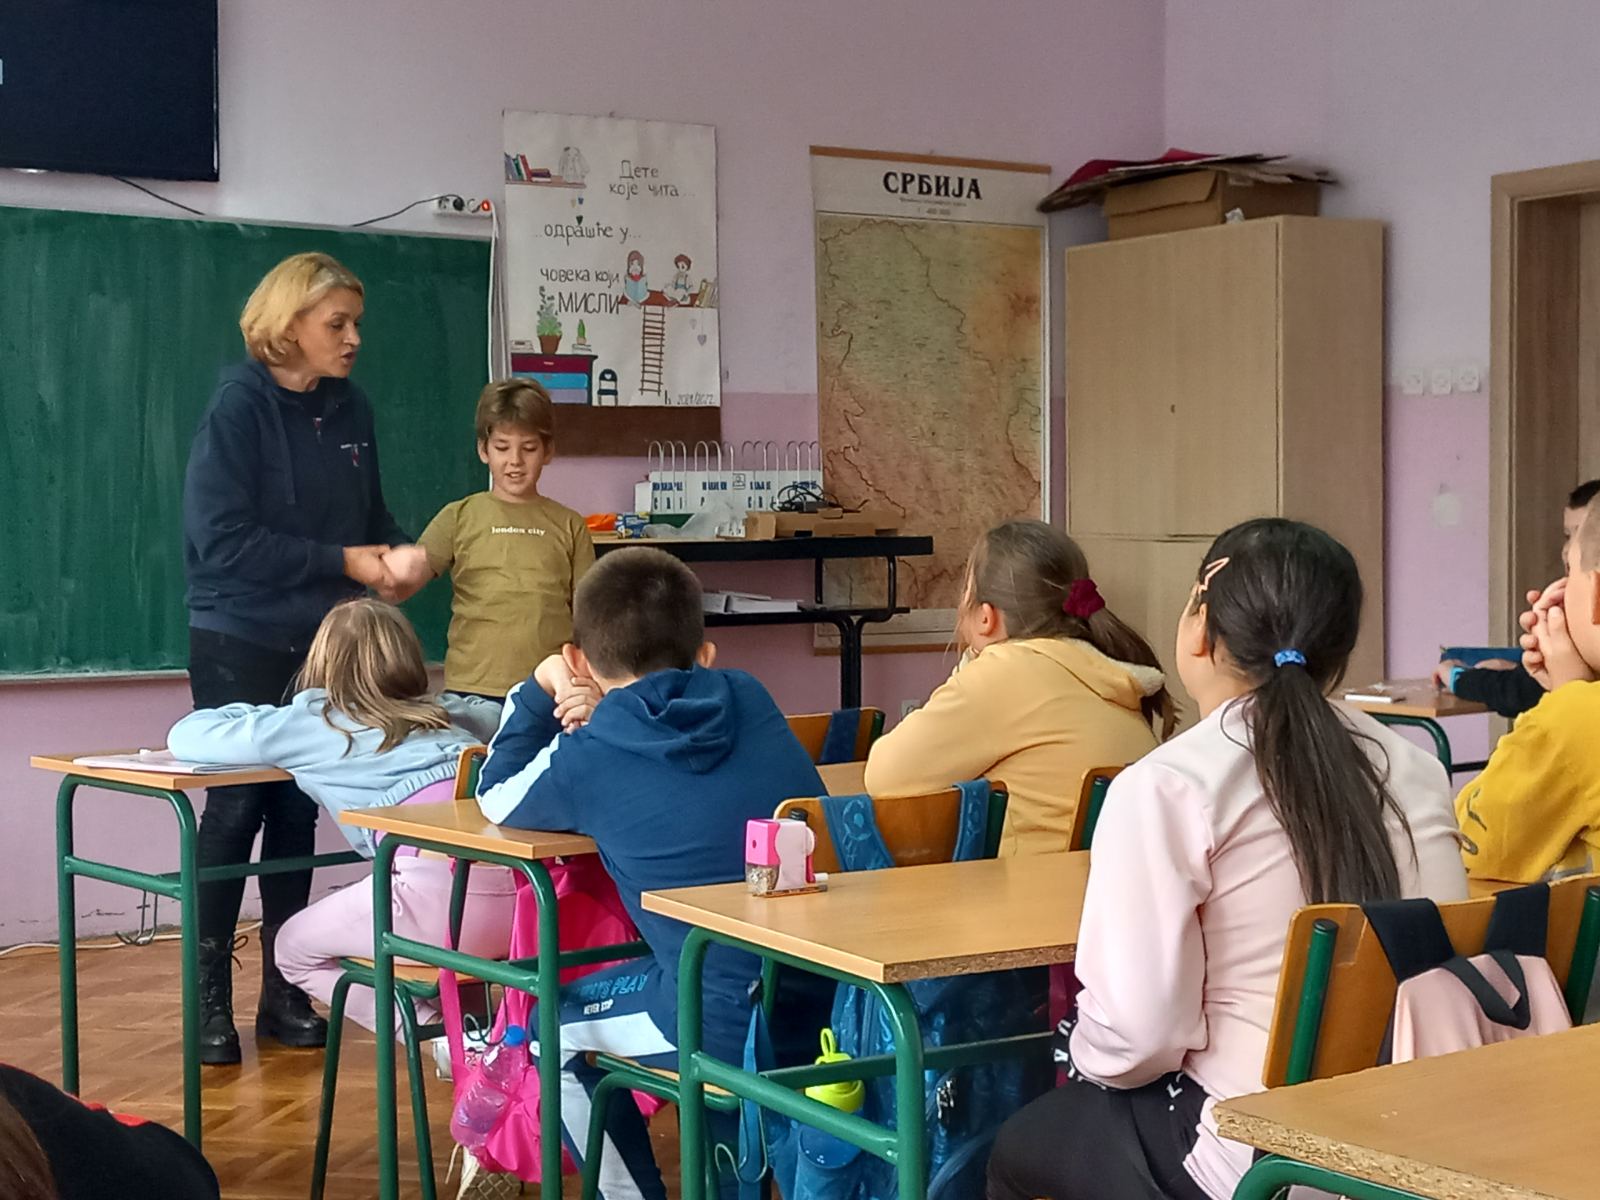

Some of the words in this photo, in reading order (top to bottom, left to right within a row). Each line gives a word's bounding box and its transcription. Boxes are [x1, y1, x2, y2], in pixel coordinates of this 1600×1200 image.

[619, 159, 659, 179] Дете
[609, 181, 640, 200] које
[882, 171, 983, 200] СРБИЈА
[540, 268, 591, 283] човека
[594, 269, 620, 288] који
[558, 291, 620, 315] МИСЛИ
[491, 526, 525, 534] london
[528, 528, 545, 536] city
